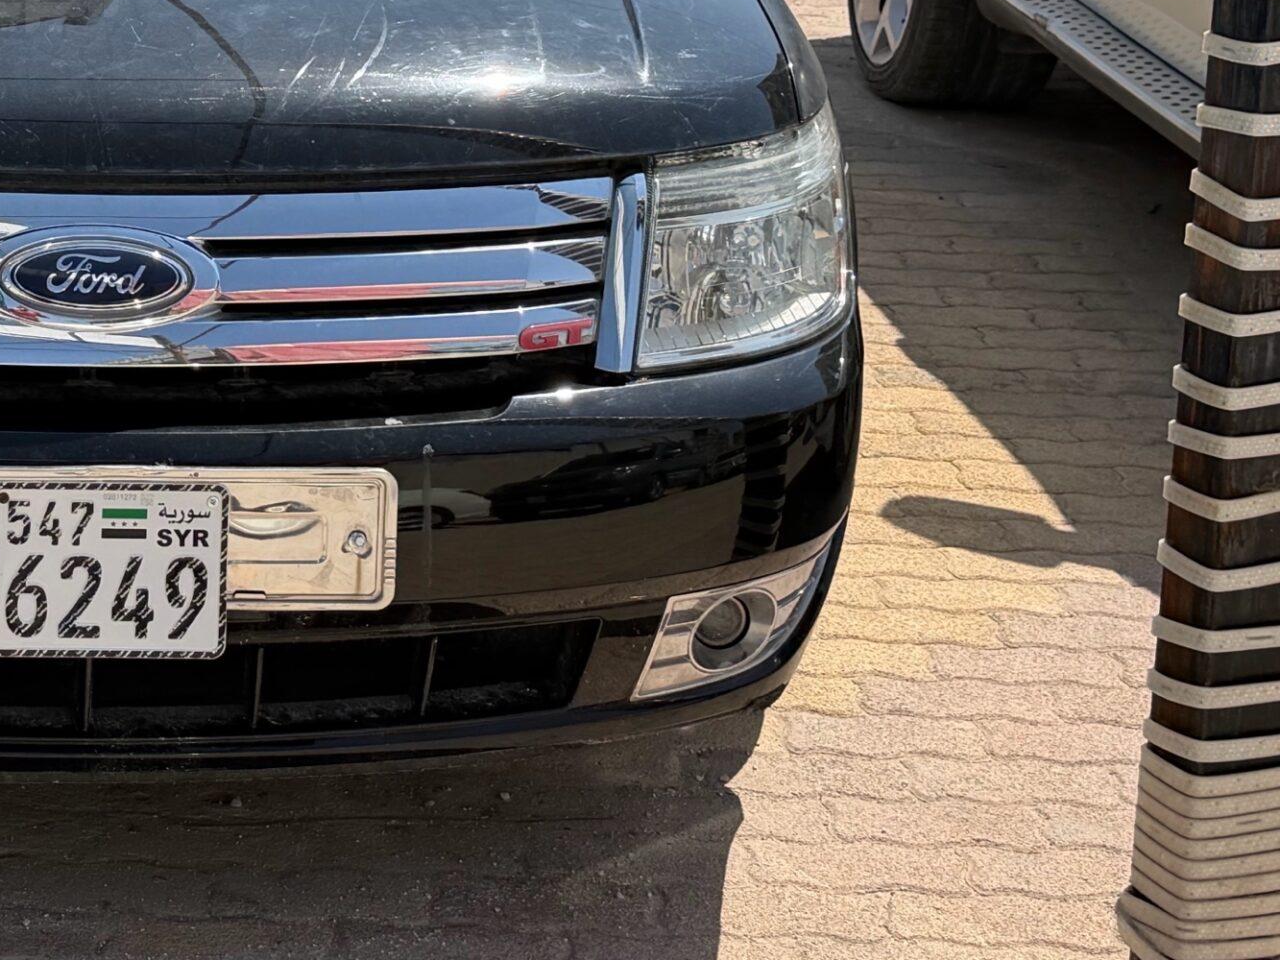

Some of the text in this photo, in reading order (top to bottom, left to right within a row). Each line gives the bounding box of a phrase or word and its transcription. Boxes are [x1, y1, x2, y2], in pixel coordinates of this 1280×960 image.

[46, 253, 145, 296] Ford
[519, 318, 593, 350] GT
[6, 500, 95, 546] 547
[157, 502, 211, 525] سورية
[156, 529, 210, 548] SYR
[5, 554, 209, 641] 6249
